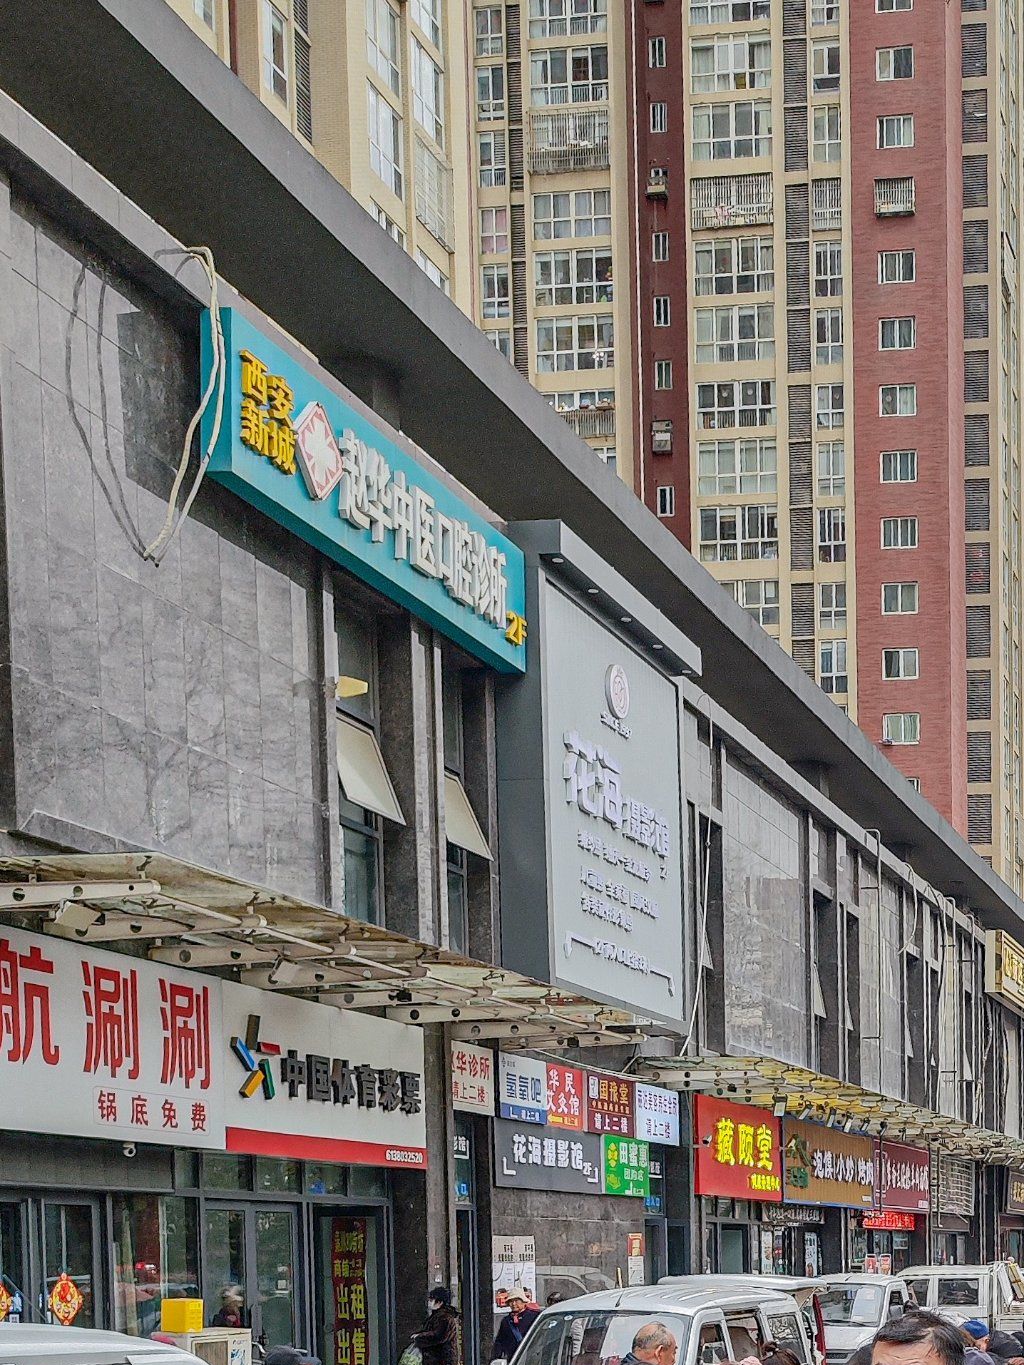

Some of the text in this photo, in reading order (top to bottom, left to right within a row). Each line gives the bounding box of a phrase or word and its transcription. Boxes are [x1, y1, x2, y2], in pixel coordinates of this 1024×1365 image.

[239, 349, 295, 429] 西安
[240, 397, 297, 477] 新城
[337, 427, 508, 630] 赵华中医口腔诊所
[505, 611, 528, 647] 2F
[562, 730, 670, 859] 花海摄影馆
[280, 1049, 422, 1115] 中国体育彩票
[452, 1051, 490, 1081] 华诊所
[506, 1072, 541, 1103] 氢氧吧
[547, 1089, 580, 1115] 艾灸馆
[97, 1089, 207, 1132] 锅底免费
[594, 1112, 629, 1134] 请上二楼
[645, 1118, 671, 1140] 请上二楼
[512, 1132, 584, 1170] 花海摄影馆
[582, 1162, 592, 1176] 2F
[337, 1283, 366, 1321] 出租
[337, 1327, 366, 1365] 出售
